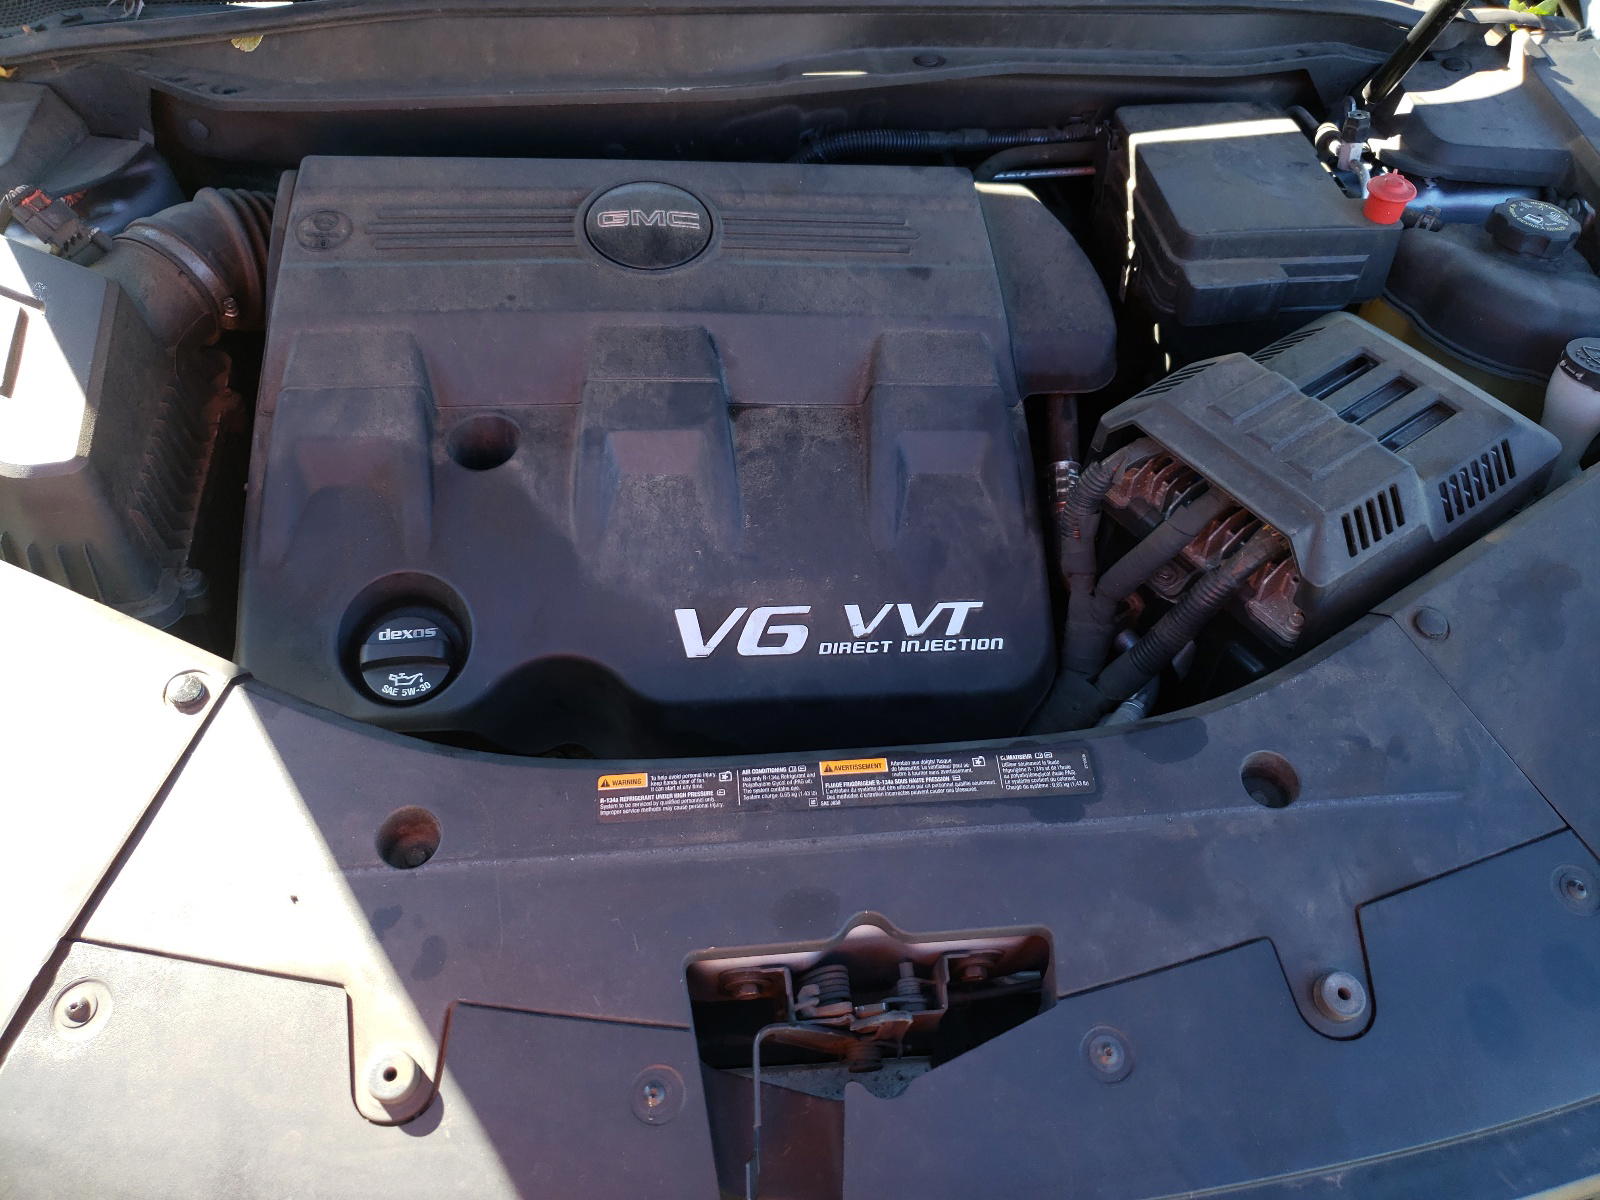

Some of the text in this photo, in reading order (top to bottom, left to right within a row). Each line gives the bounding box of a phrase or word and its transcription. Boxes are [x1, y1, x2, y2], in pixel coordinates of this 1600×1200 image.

[597, 209, 700, 230] GMC
[379, 627, 439, 640] dexos
[674, 601, 984, 658] V6 VVT
[819, 638, 1003, 655] DIRECT INJECTION
[382, 682, 431, 697] SAE 5W-30
[834, 763, 882, 771] AVERTISSEMENT
[612, 778, 642, 786] WARNING
